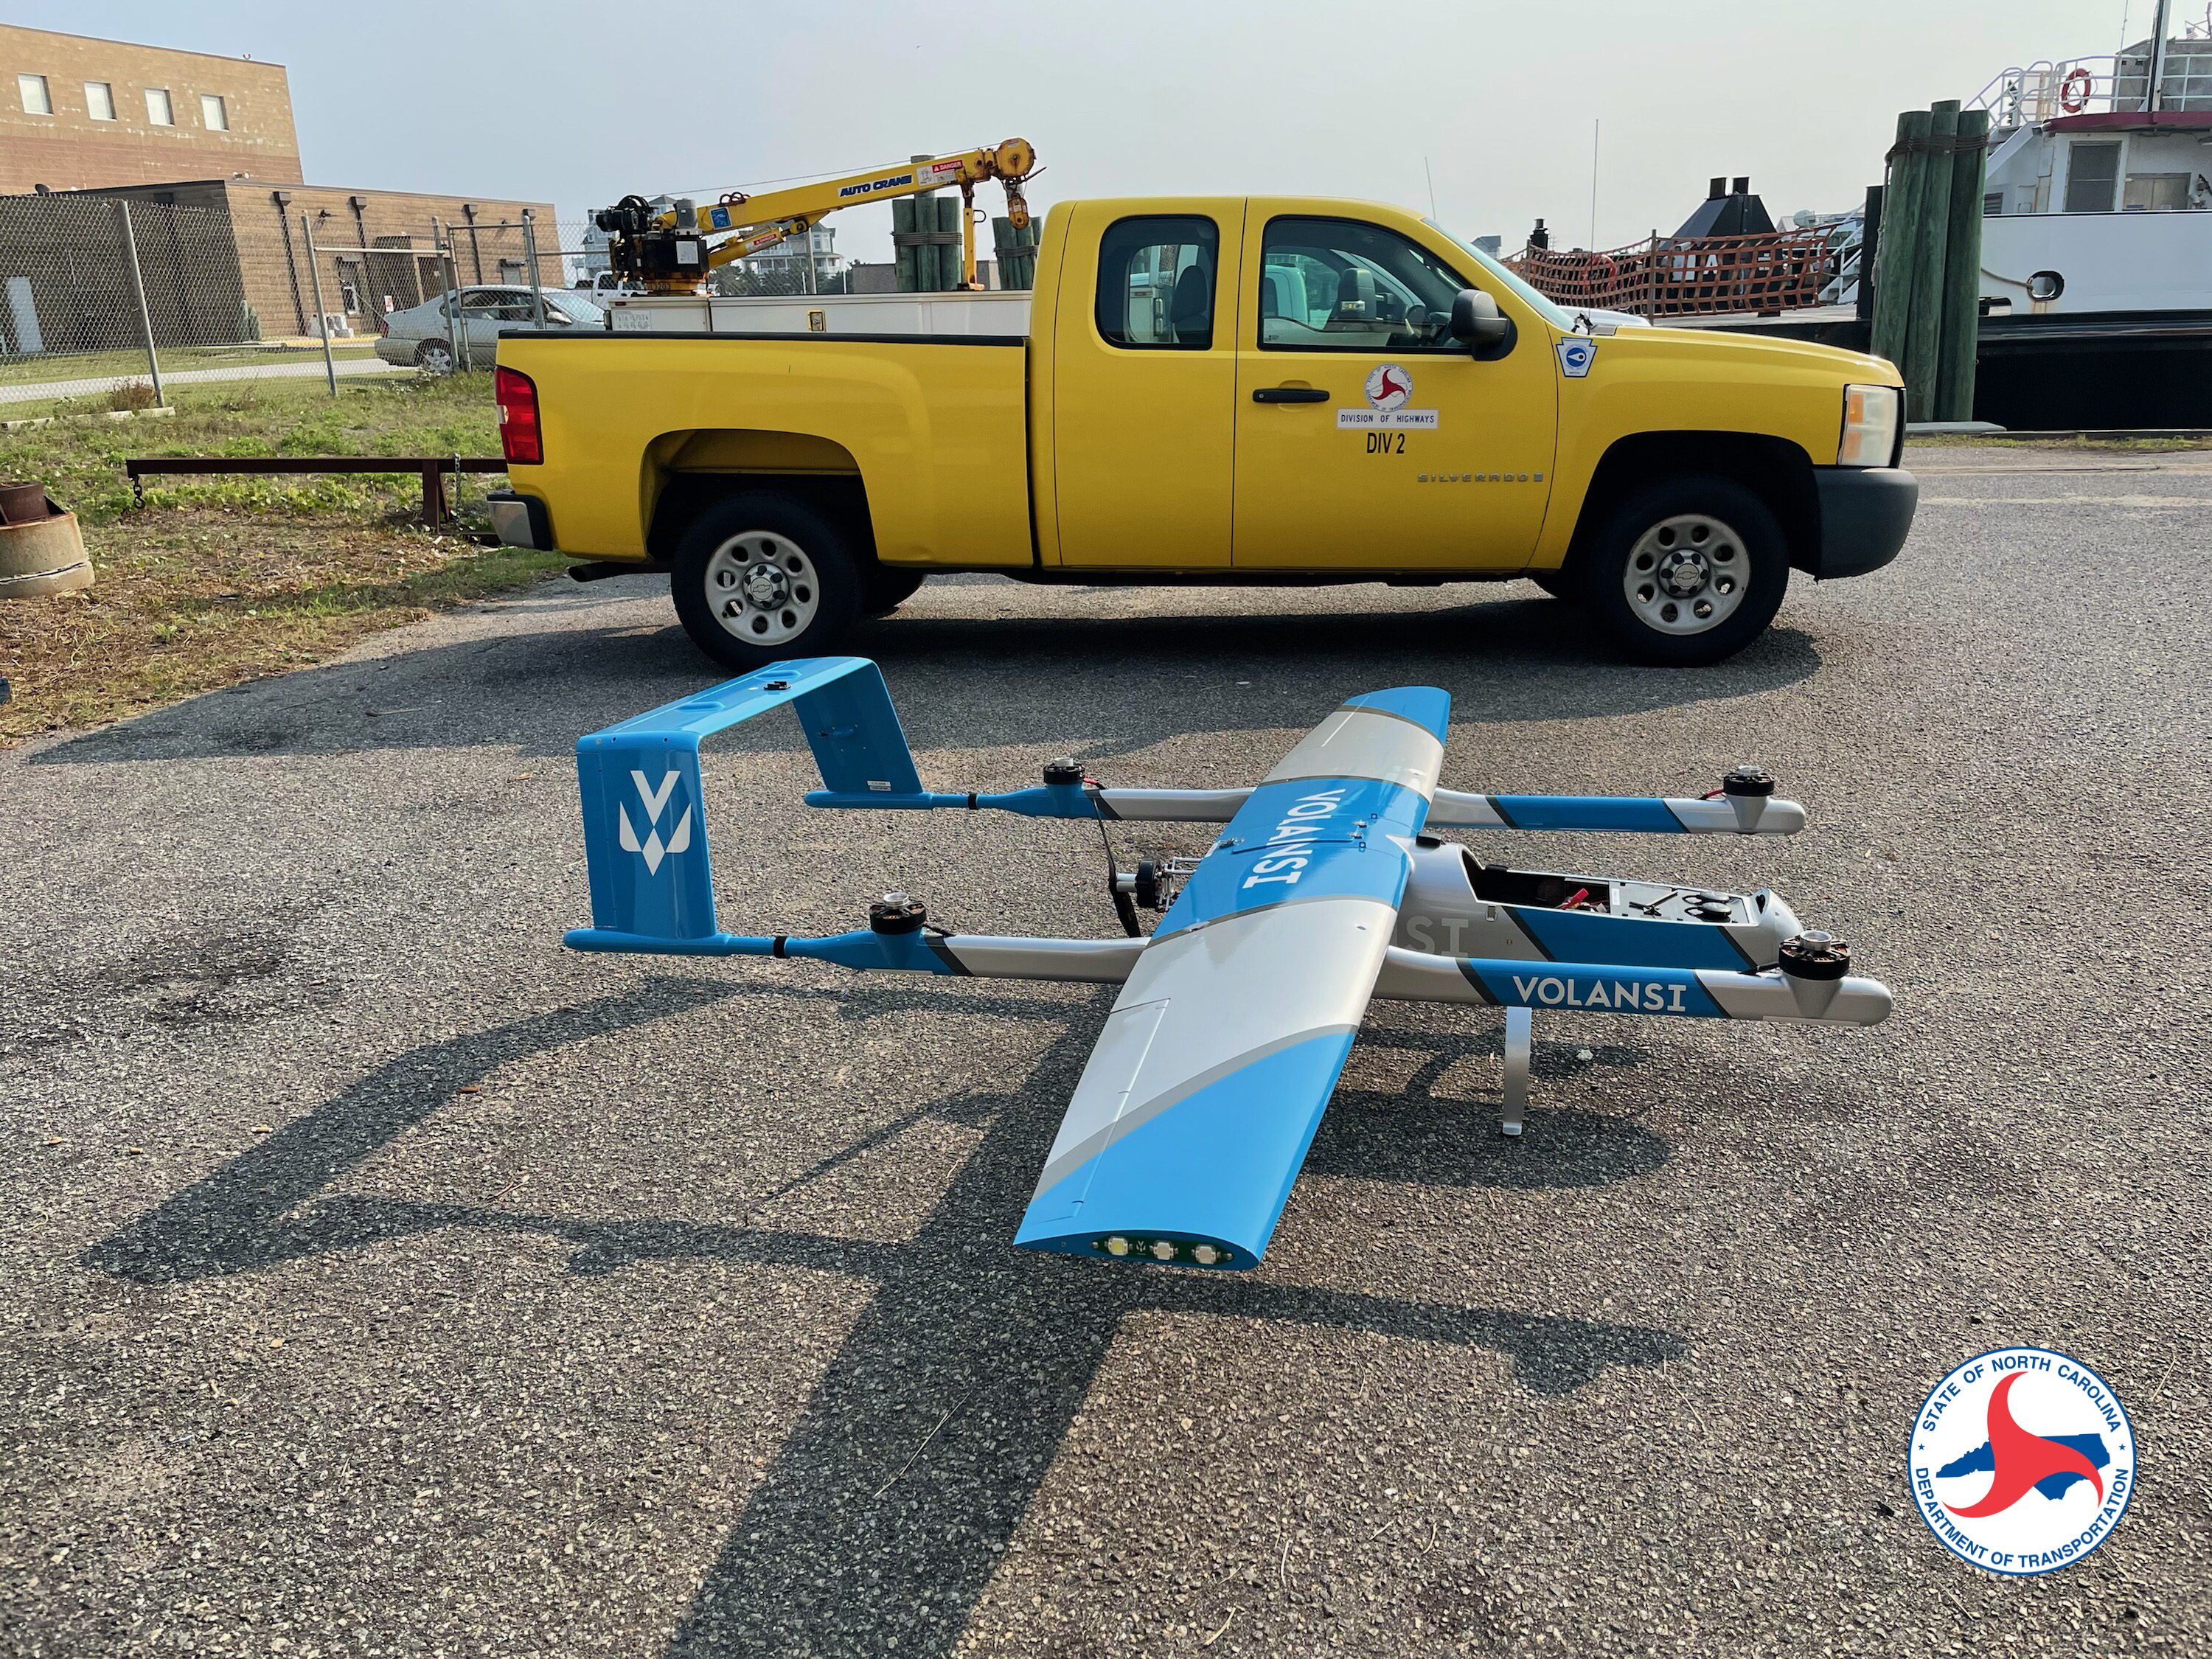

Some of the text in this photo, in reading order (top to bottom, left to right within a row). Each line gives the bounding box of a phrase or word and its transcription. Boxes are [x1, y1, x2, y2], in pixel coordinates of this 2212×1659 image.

[840, 183, 871, 197] AUTO
[1341, 414, 1435, 423] DIVISION OF HIGHWAYS
[1366, 432, 1405, 454] DIV 2
[1417, 473, 1528, 482] SILVERADO
[1242, 788, 1346, 888] VOLANSI
[1512, 975, 1687, 1012] VOLANSI
